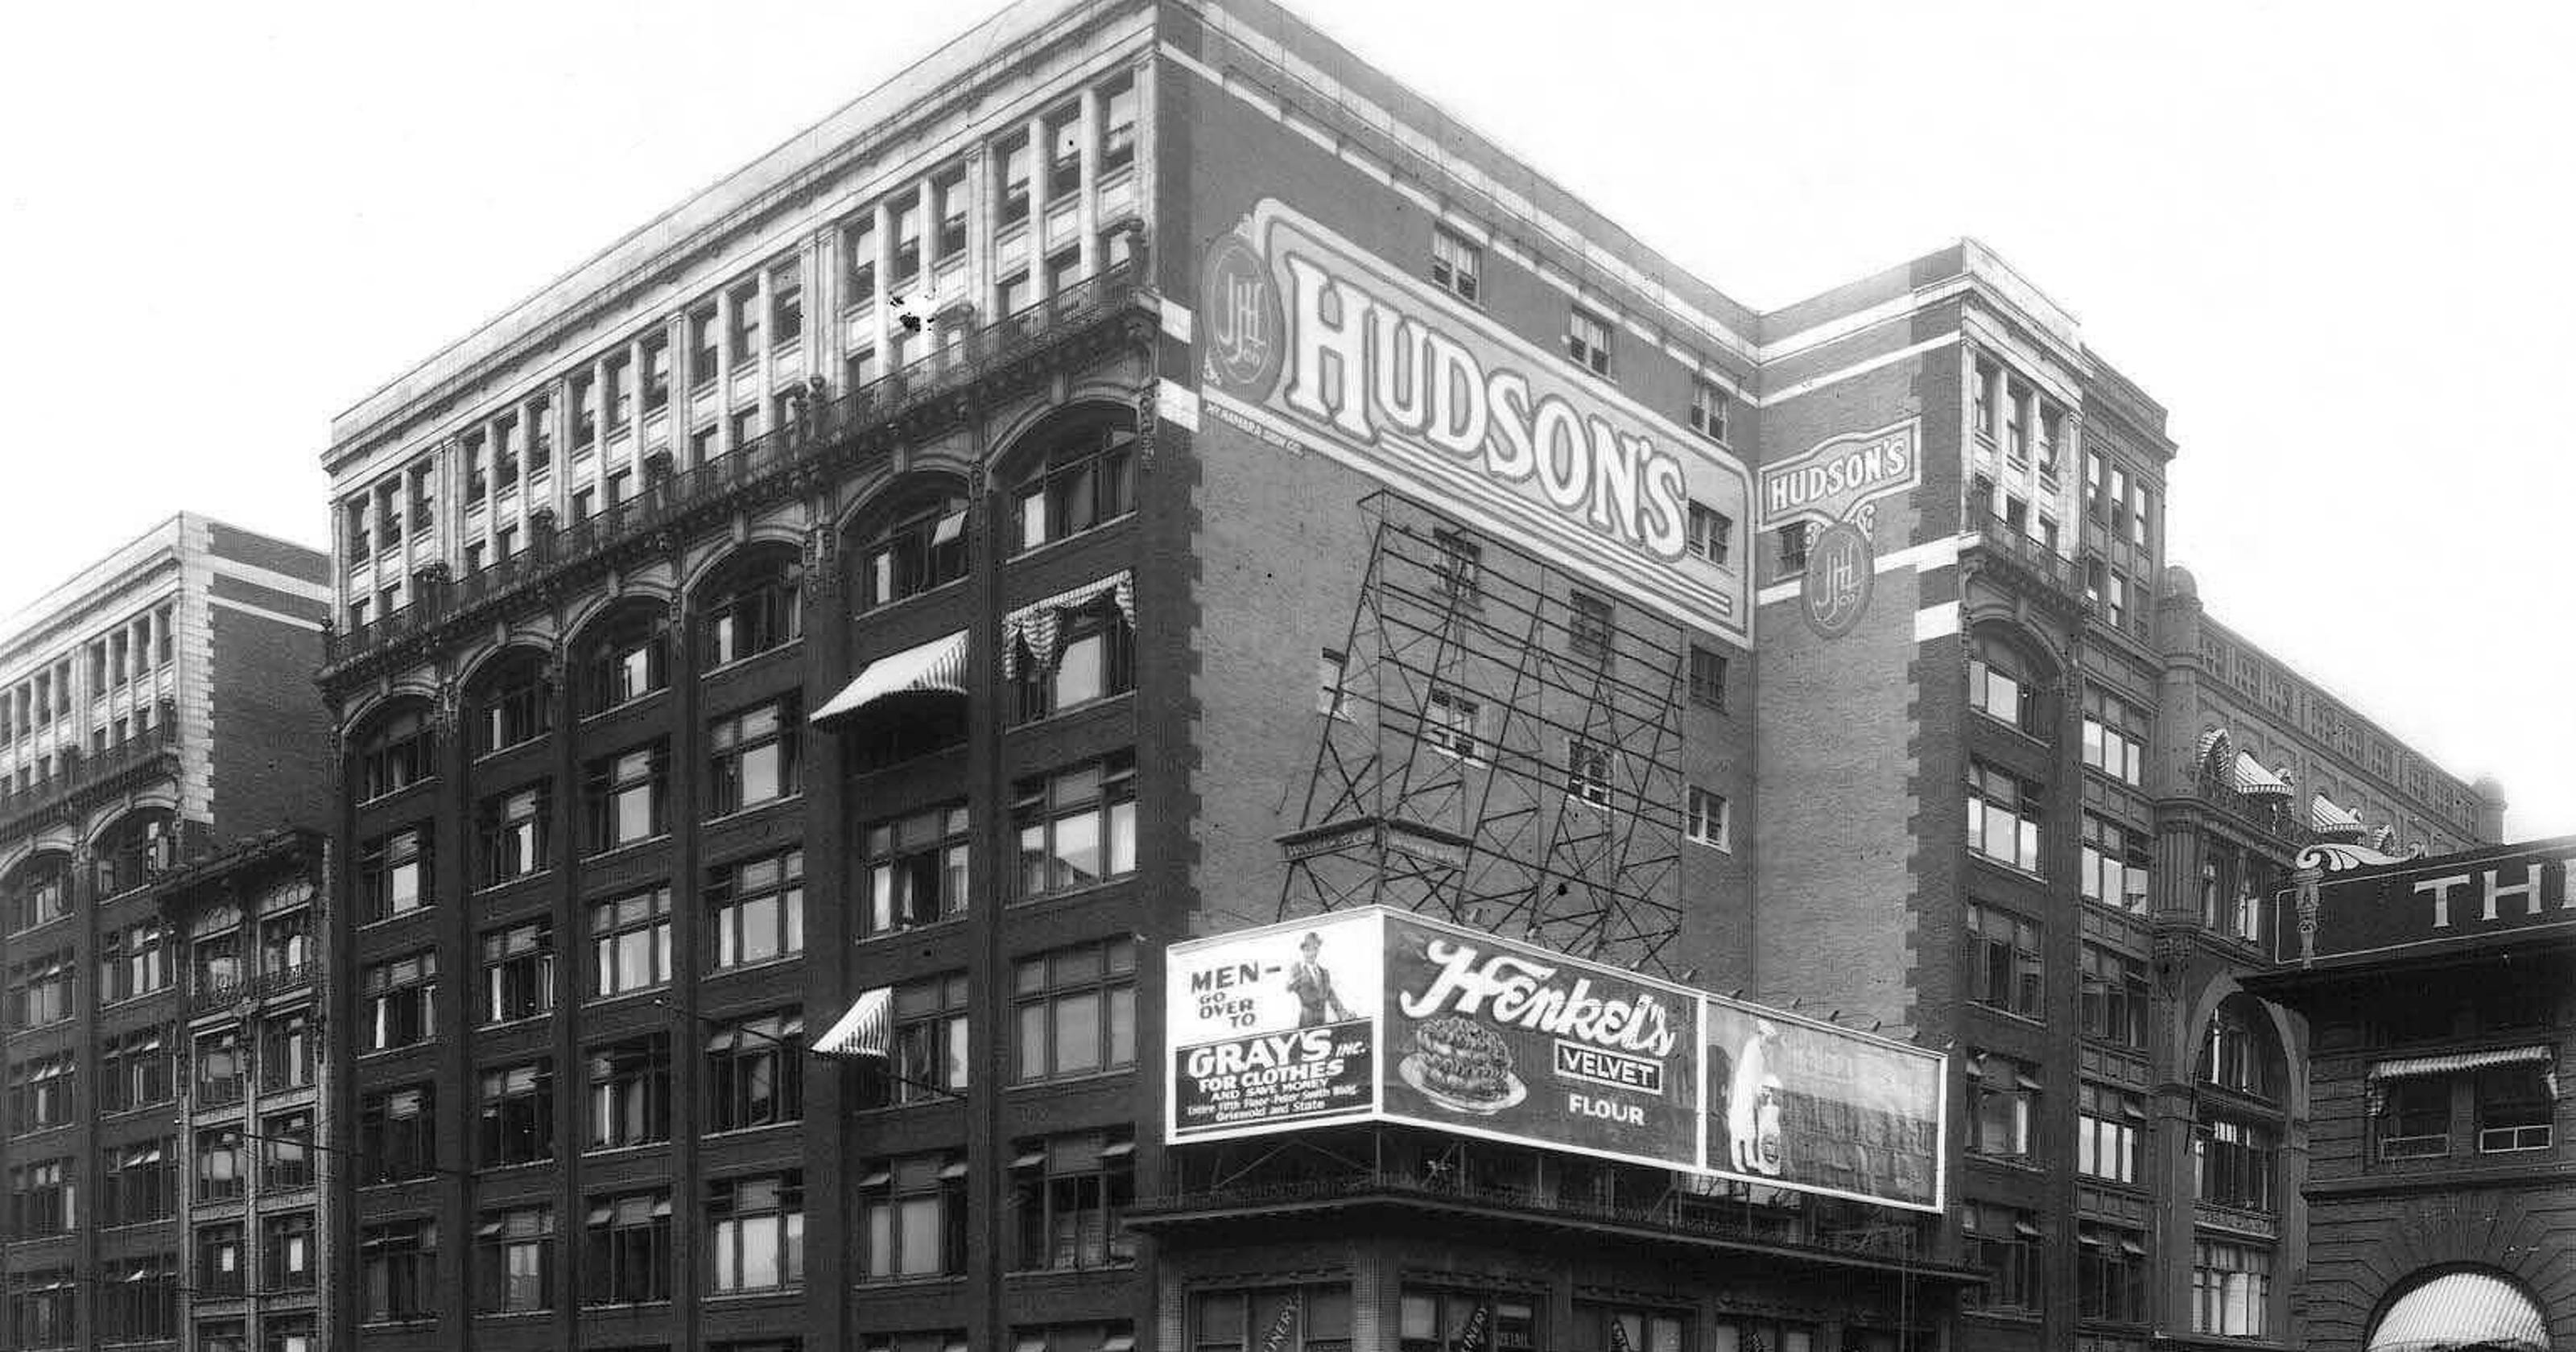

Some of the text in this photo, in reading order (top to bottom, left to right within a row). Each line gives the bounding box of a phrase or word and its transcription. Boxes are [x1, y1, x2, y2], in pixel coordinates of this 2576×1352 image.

[1286, 255, 1688, 561] HUDSON'S
[1770, 439, 1905, 513] HUDSON'S
[1199, 991, 1226, 1005] GO
[1199, 999, 1254, 1020] OVER
[1231, 1012, 1256, 1028] TO
[1199, 1058, 1344, 1093] FOR CLOTHES
[1563, 1049, 1655, 1086] VELVET
[1211, 1078, 1329, 1102] AND SAVE MONEY
[1293, 1099, 1326, 1112] State
[1568, 1093, 1646, 1126] FLOUR
